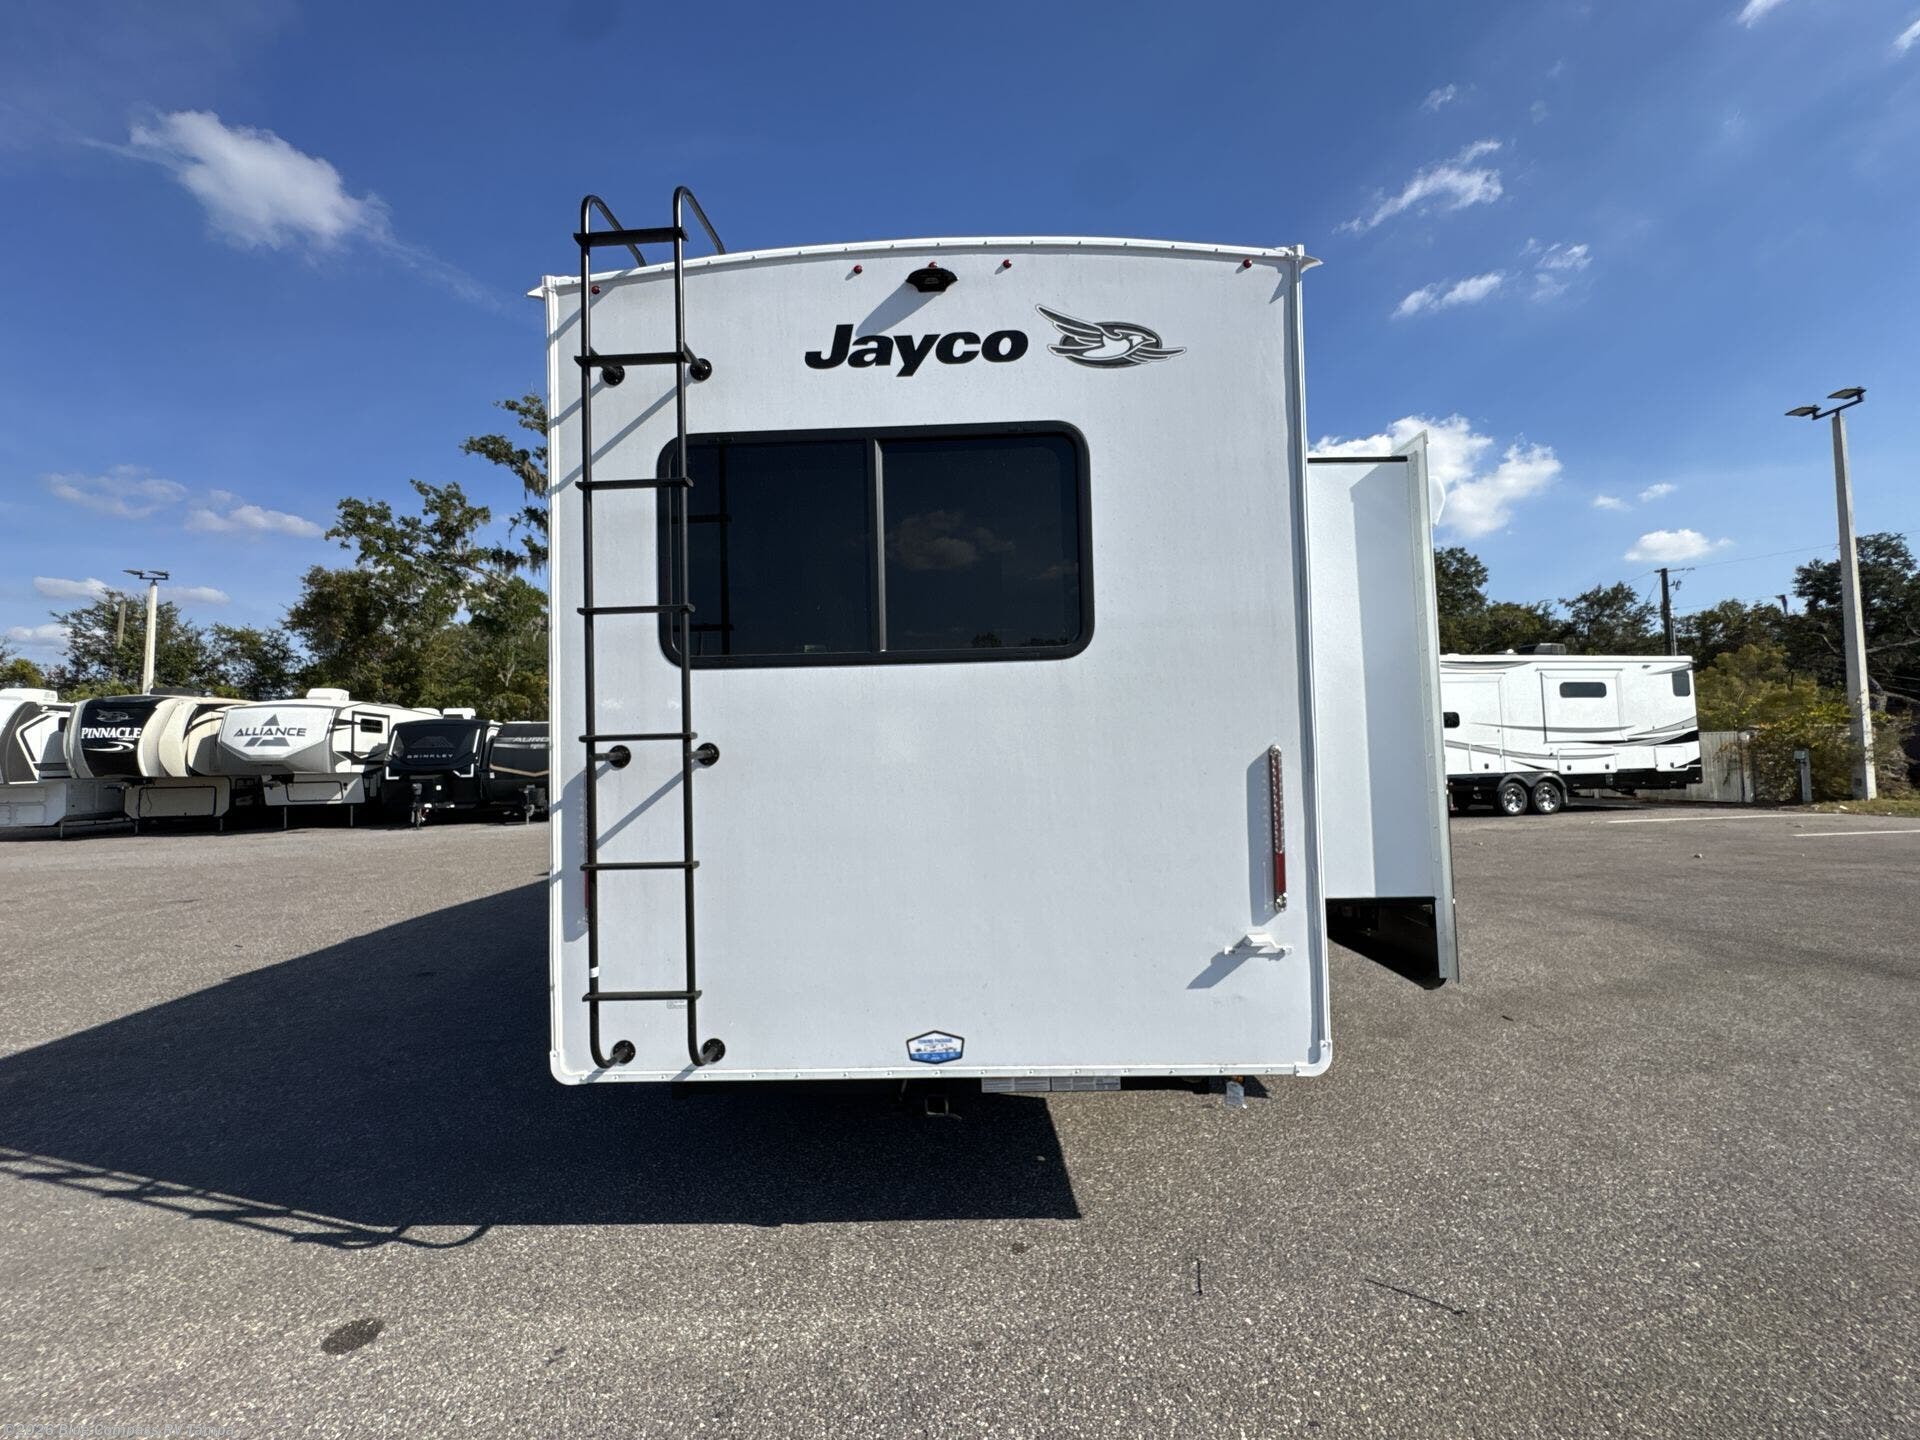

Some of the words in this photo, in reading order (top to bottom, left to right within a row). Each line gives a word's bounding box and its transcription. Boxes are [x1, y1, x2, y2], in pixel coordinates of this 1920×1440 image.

[804, 324, 1029, 377] Jayco
[81, 727, 142, 739] PINNACLE
[233, 727, 307, 737] ALLIANCE
